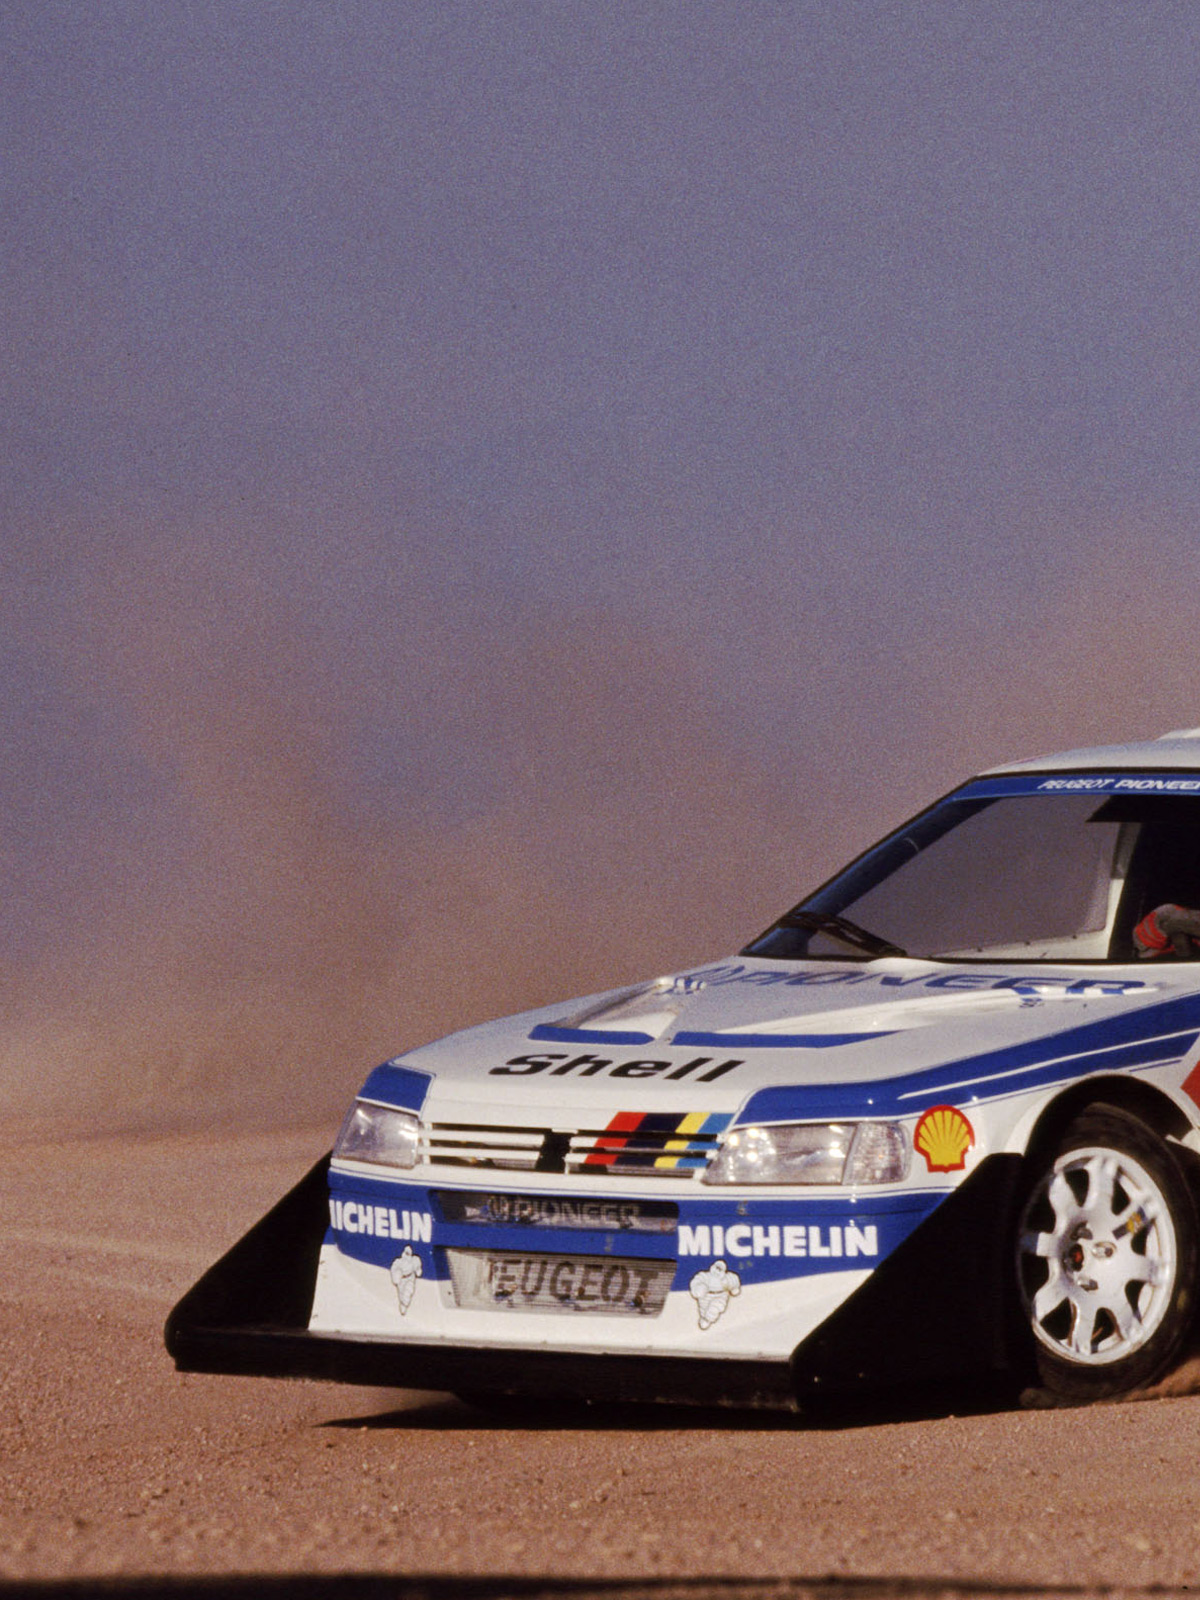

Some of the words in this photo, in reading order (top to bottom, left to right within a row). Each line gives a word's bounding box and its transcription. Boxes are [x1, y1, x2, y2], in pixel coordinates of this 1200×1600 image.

[490, 1053, 747, 1083] Shell
[678, 1224, 878, 1257] MICHELIN
[488, 1257, 659, 1305] EUGEOT
